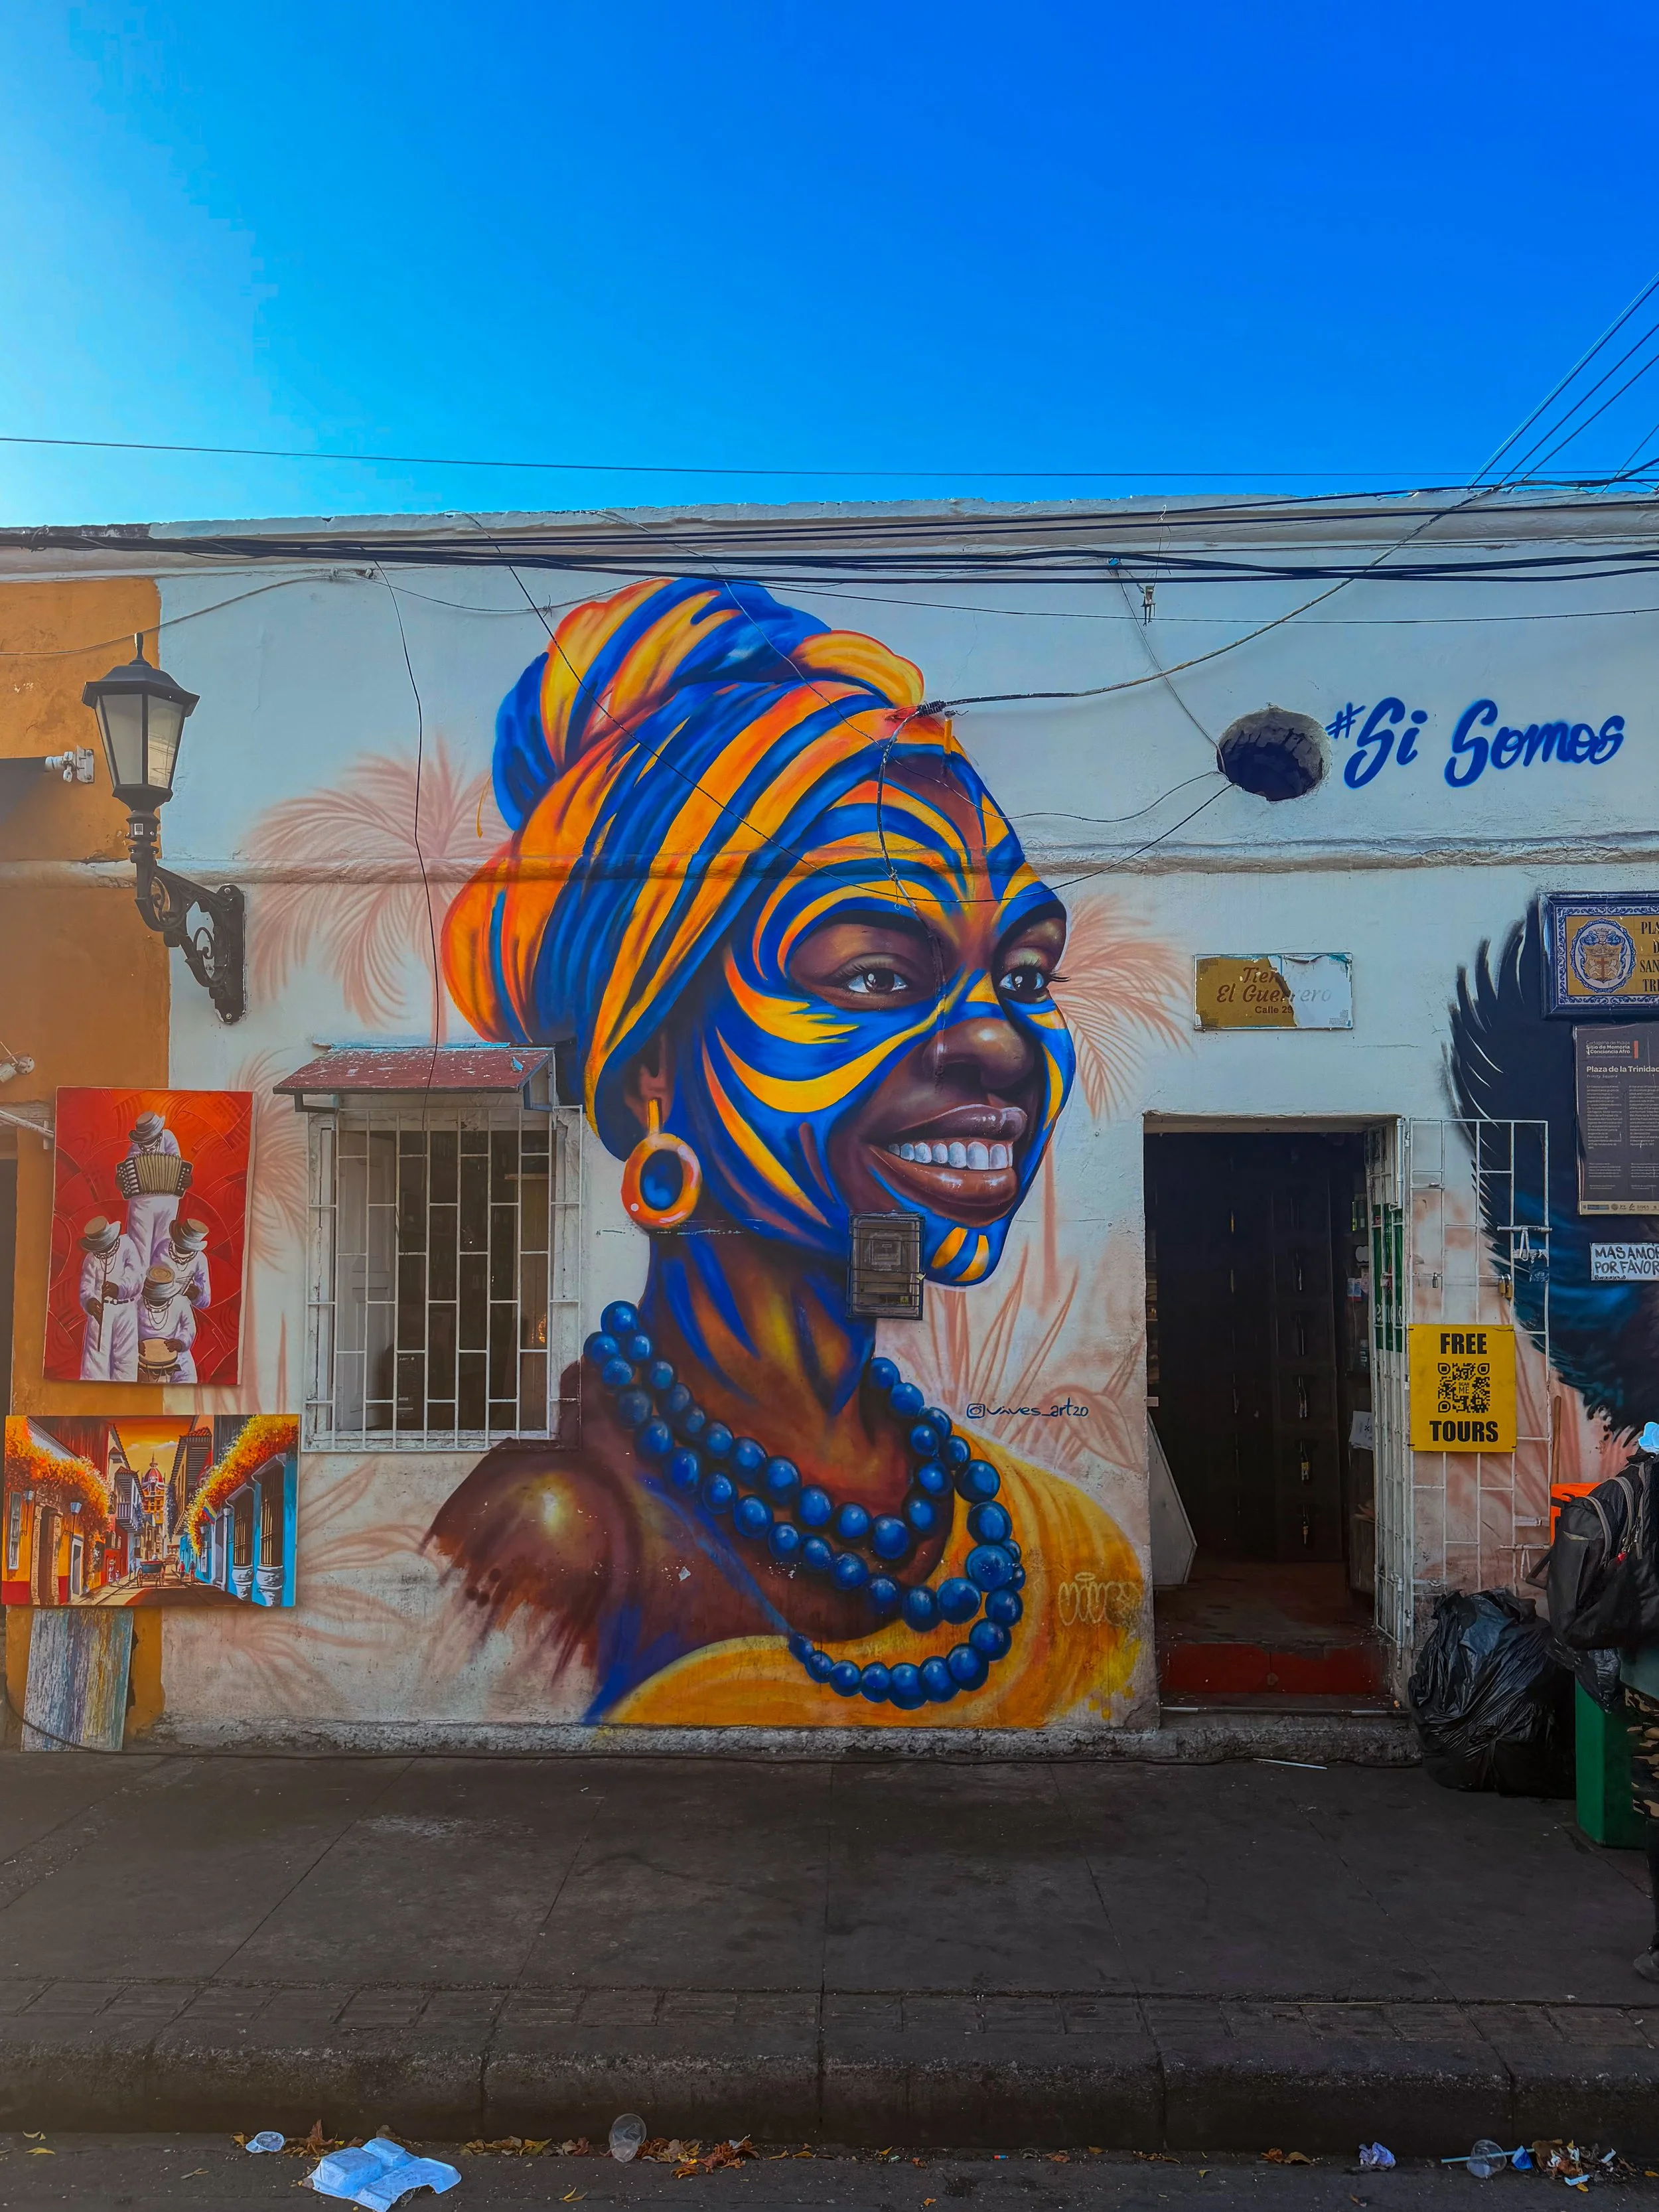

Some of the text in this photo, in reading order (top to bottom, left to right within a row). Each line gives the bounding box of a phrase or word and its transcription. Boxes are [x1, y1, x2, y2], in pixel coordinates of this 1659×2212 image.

[1444, 699, 1625, 788] Somos
[1216, 983, 1236, 1003] El
[1595, 1246, 1626, 1260] MAS
[1595, 1261, 1619, 1274] POR
[1440, 1333, 1487, 1355] FREE
[987, 1397, 1089, 1417] vives_art20
[1429, 1420, 1499, 1442] TOURS
